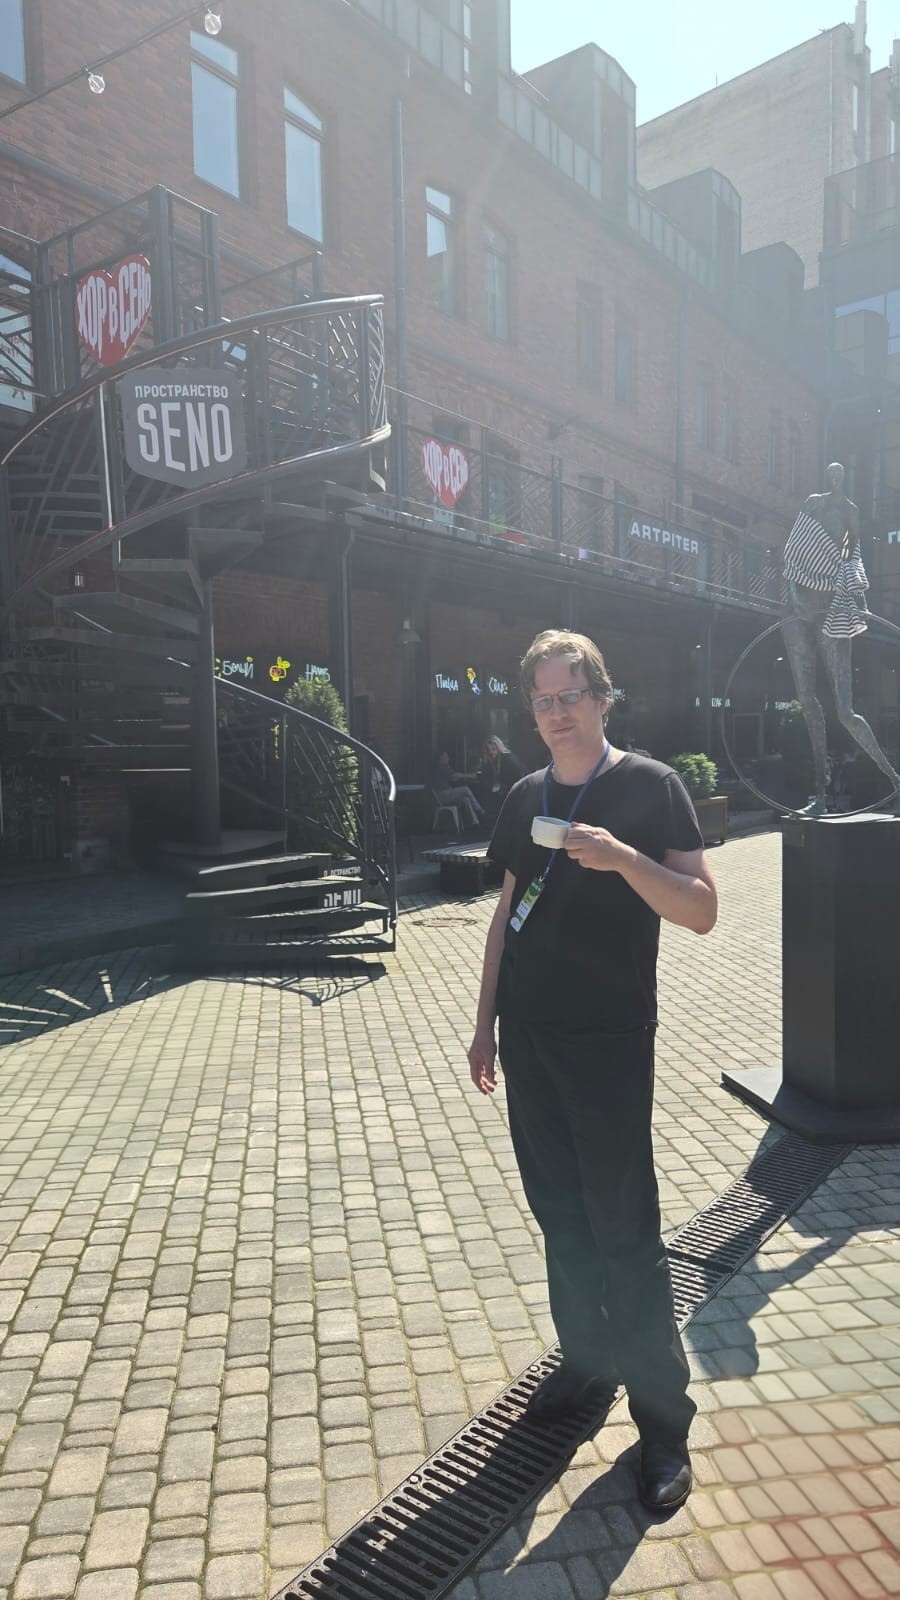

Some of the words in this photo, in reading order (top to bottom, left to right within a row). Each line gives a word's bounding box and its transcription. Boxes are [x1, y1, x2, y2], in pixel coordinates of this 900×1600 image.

[77, 275, 107, 357] ХОР
[119, 262, 152, 348] СЕНО
[134, 384, 229, 398] ПРОСТРАНСТВО
[137, 402, 233, 472] SENO
[630, 521, 699, 554] ARTPITER
